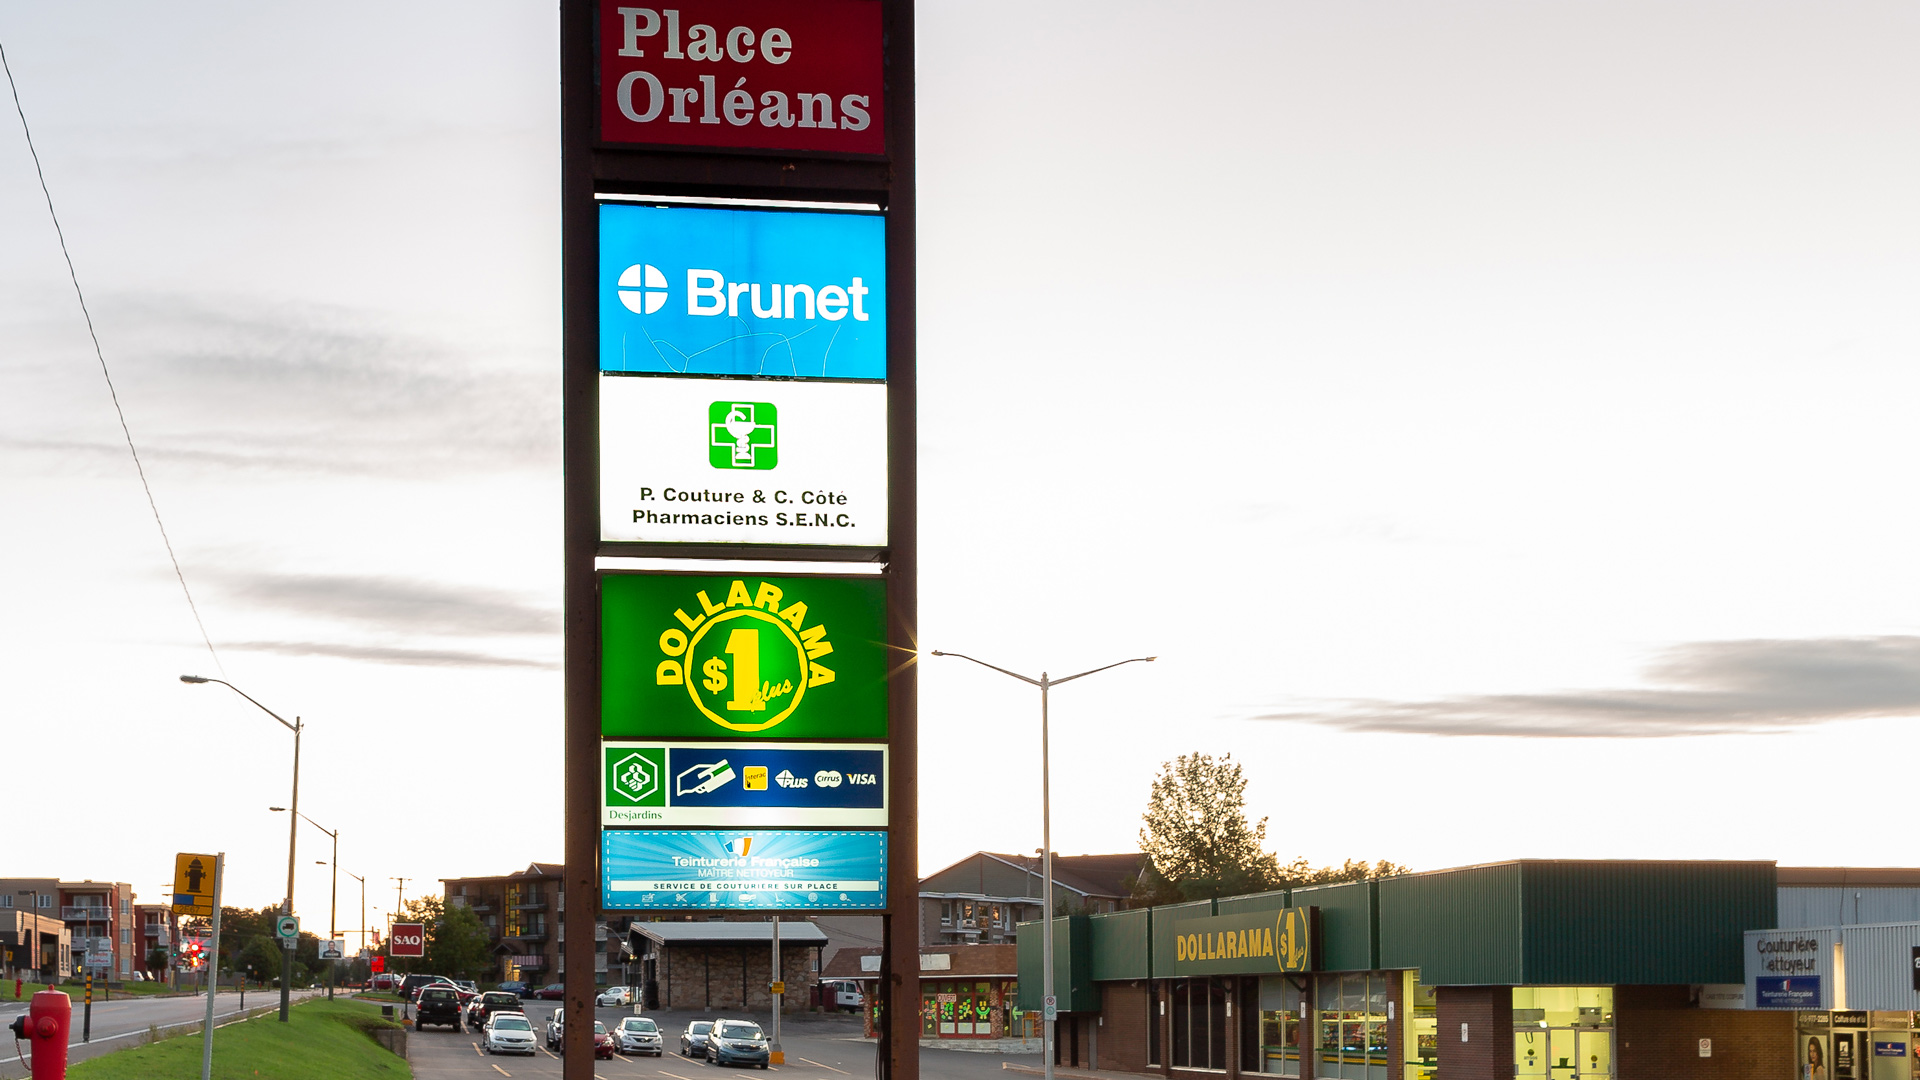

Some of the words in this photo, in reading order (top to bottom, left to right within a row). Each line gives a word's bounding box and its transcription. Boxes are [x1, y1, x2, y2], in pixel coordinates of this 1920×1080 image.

[617, 7, 793, 65] Place
[616, 70, 871, 132] Orléans
[686, 268, 870, 322] Brunet
[640, 487, 656, 502] P.
[663, 487, 745, 504] Couture
[752, 489, 766, 504] &
[774, 490, 794, 505] C.
[801, 489, 848, 506] Côté
[632, 509, 769, 527] Pharmaciens
[775, 512, 856, 528] S.E.N.C.
[656, 580, 836, 689] DOLLARAMA
[783, 777, 809, 789] PLUS
[816, 775, 840, 783] Cirrus
[846, 773, 877, 785] VISA
[609, 810, 663, 822] Desjardins
[671, 856, 747, 868] Teinturerie
[750, 856, 820, 870] Française
[697, 866, 734, 878] MAÎTRE
[736, 868, 794, 878] NETTOYEUR
[393, 935, 421, 946] SAQ
[1177, 928, 1273, 961] DOLLARAMA
[1757, 936, 1817, 954] Couturière
